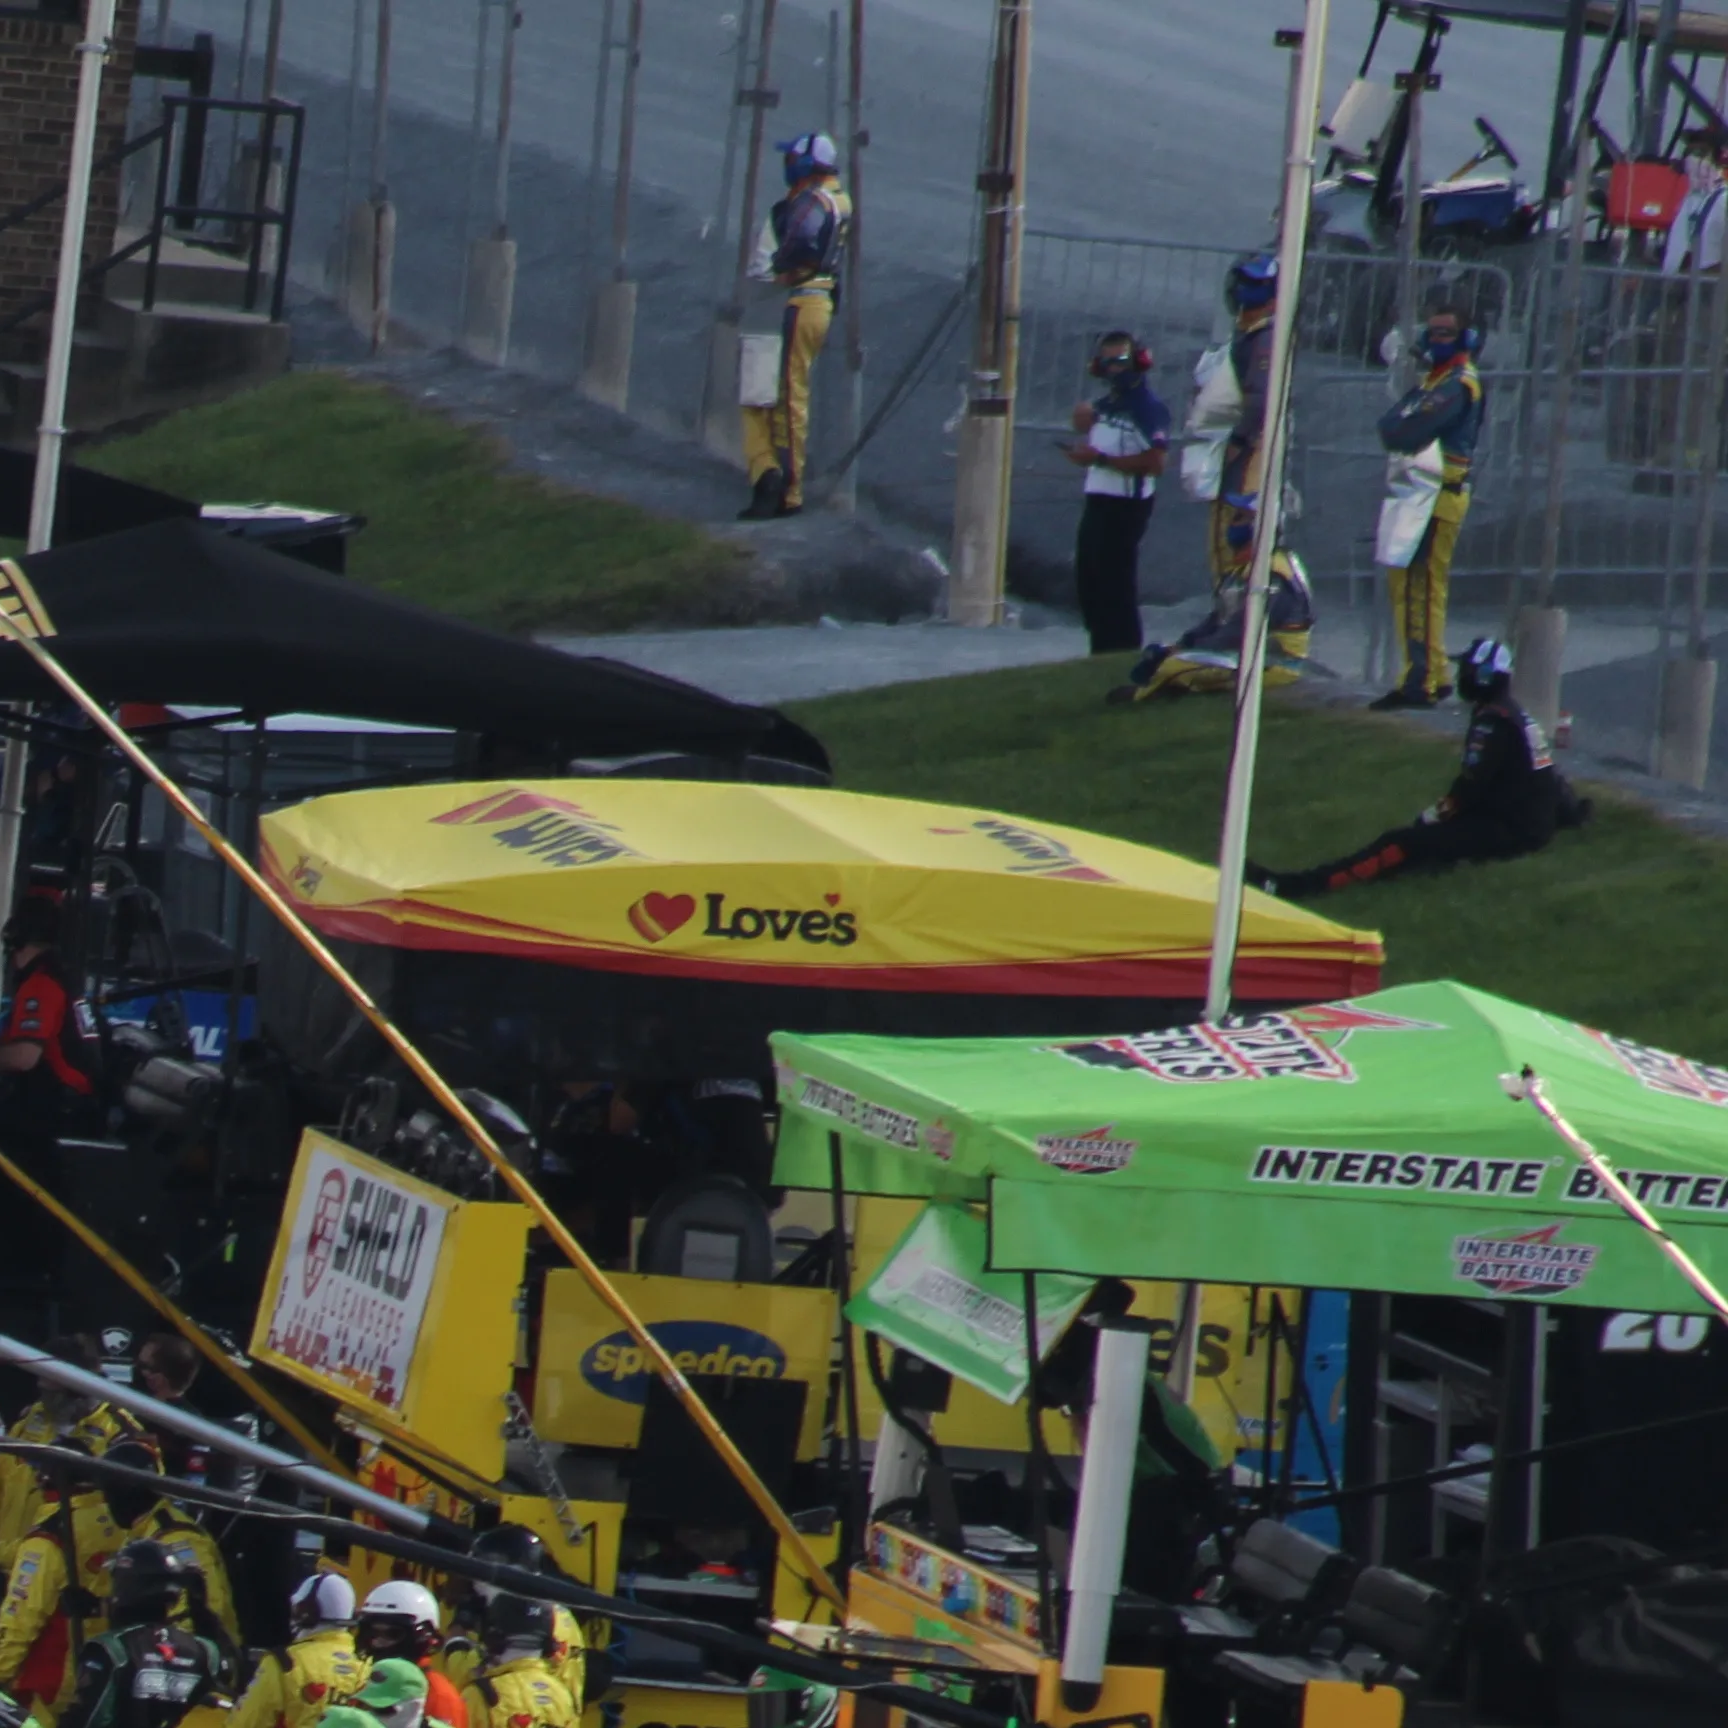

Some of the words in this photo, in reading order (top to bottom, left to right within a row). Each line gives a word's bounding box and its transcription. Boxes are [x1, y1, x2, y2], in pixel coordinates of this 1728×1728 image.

[1252, 1148, 1545, 1195] INTERSTATE
[333, 1175, 428, 1303] SHIELD
[1456, 1240, 1595, 1265] INTERSTATE
[1459, 1261, 1584, 1285] BATTERIES
